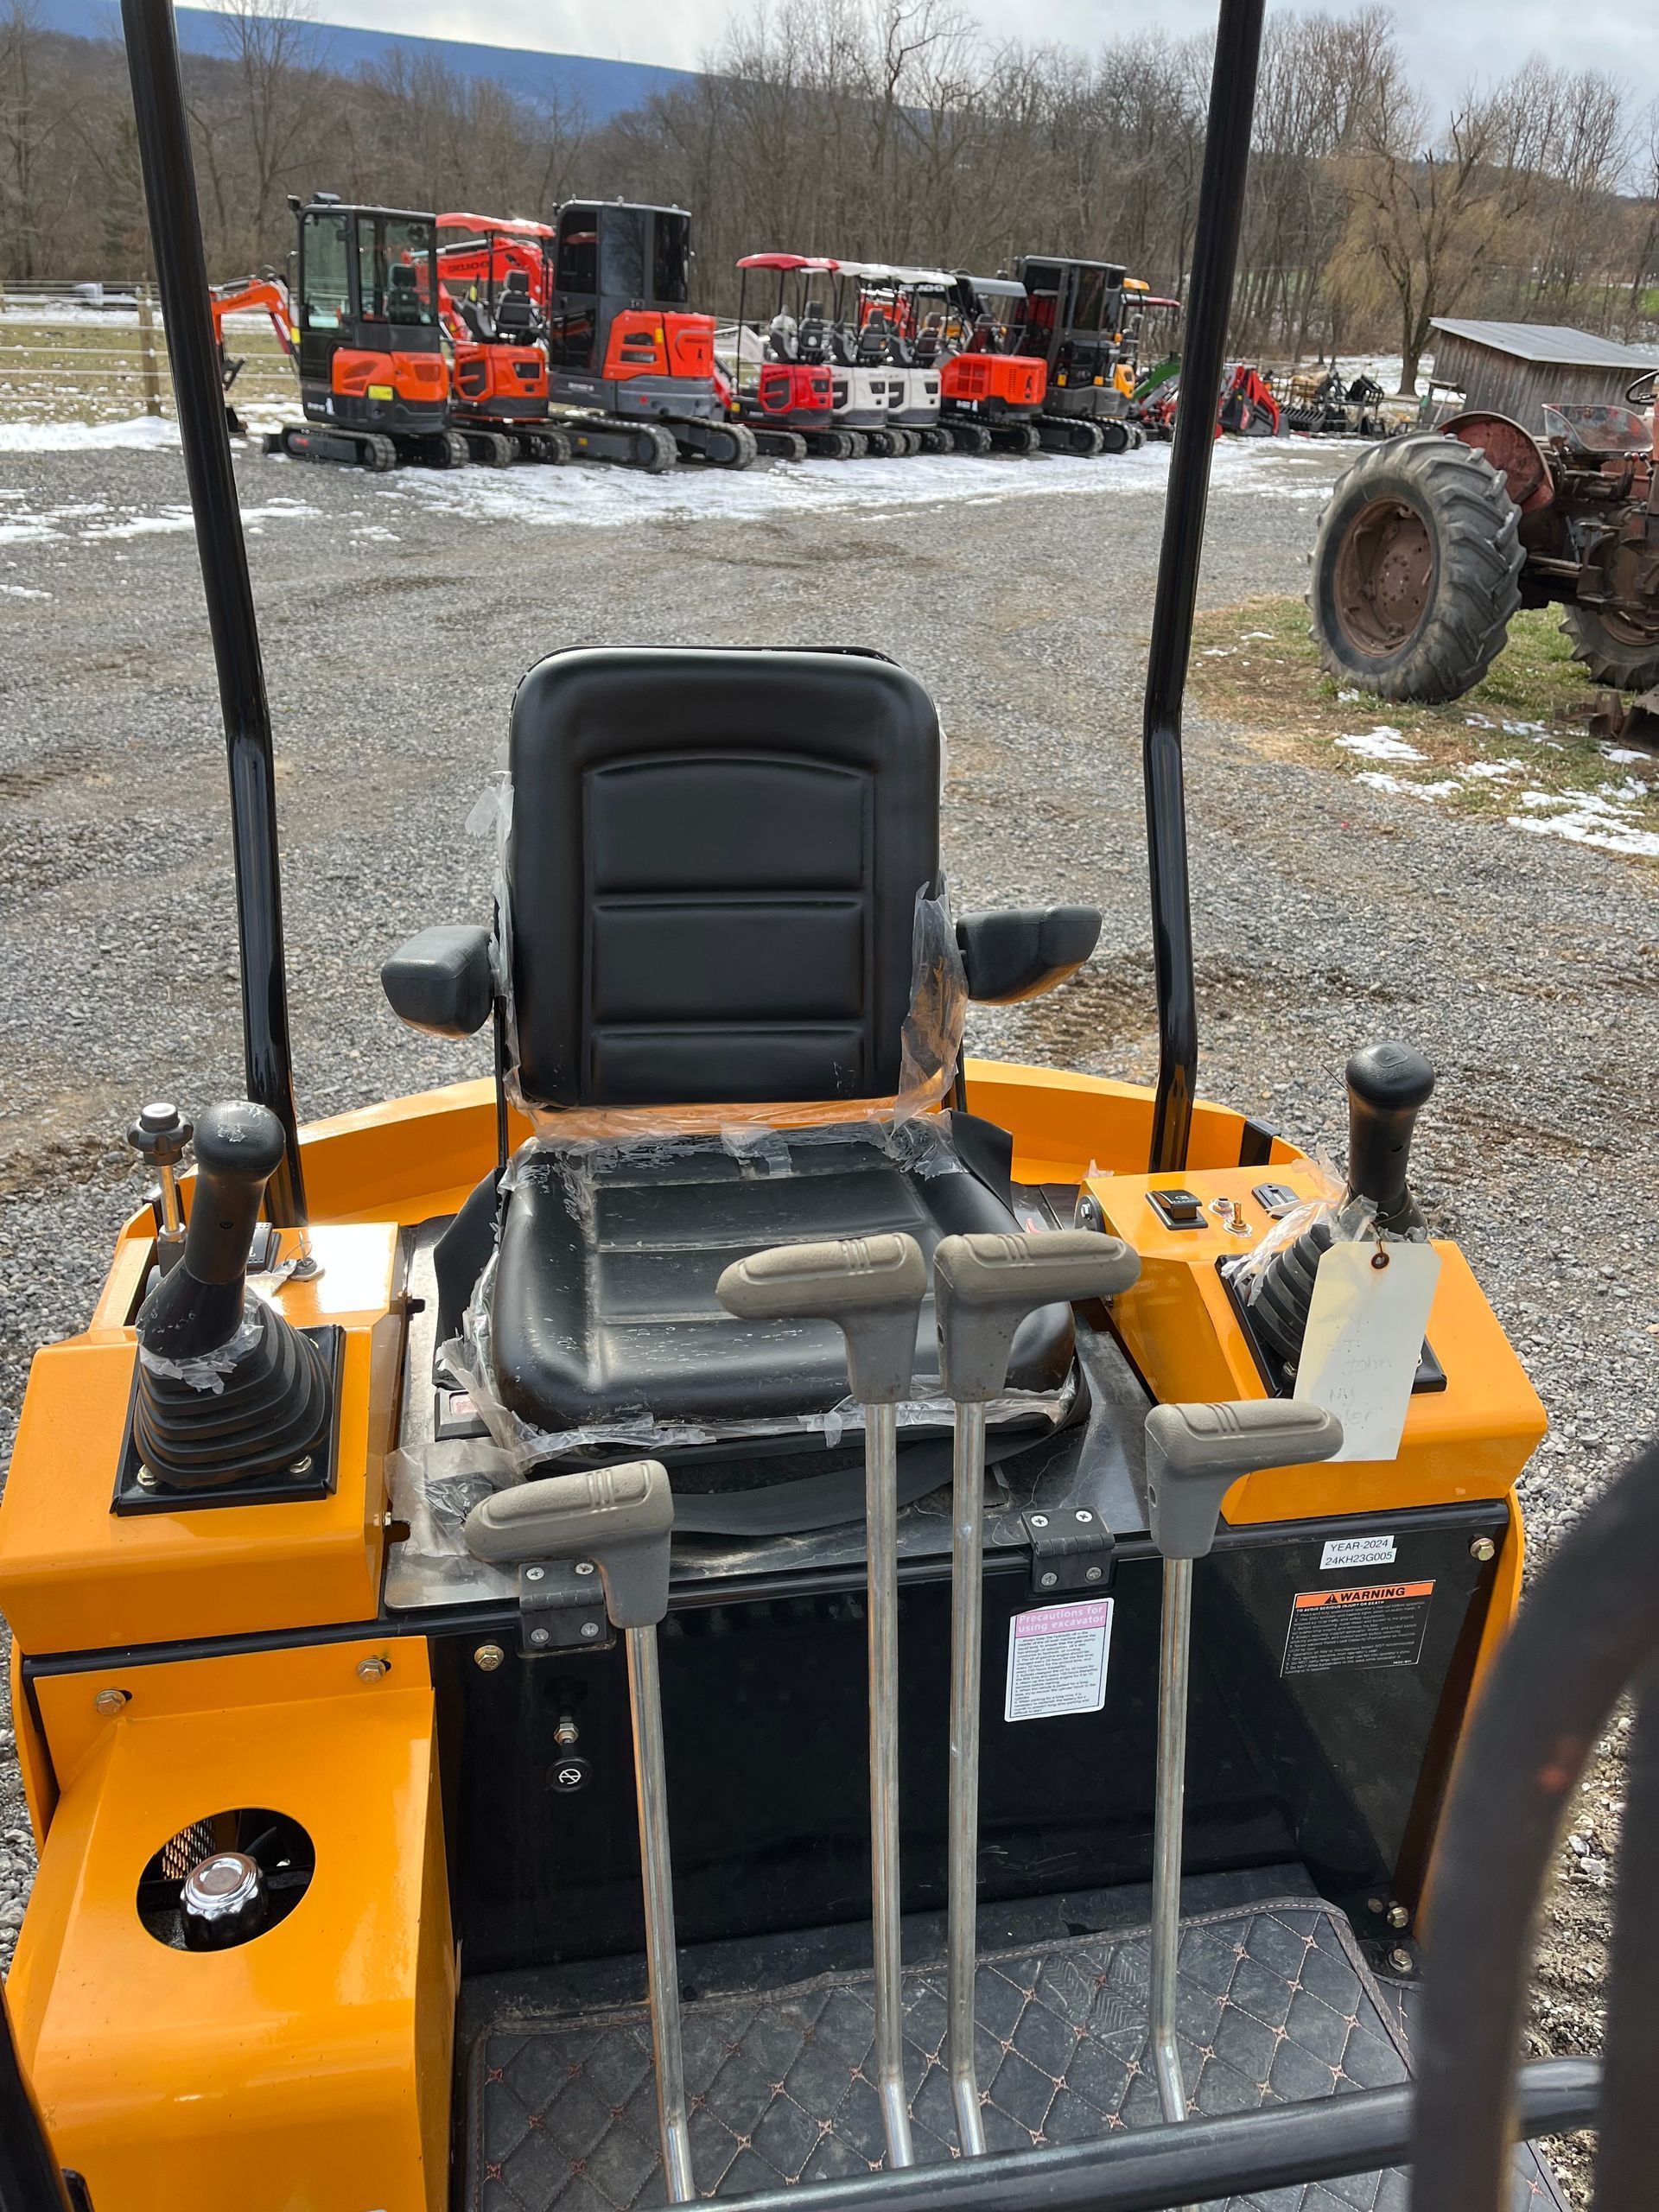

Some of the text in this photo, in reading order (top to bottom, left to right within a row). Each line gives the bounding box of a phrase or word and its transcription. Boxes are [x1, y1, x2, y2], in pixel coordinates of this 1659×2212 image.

[1331, 1539, 1389, 1552] YEAR-2024
[1325, 1552, 1393, 1565] 24KH23G005
[1340, 1587, 1406, 1602] WARNING
[1019, 1605, 1103, 1624] Precautions for
[1018, 1615, 1105, 1633] using excavator
